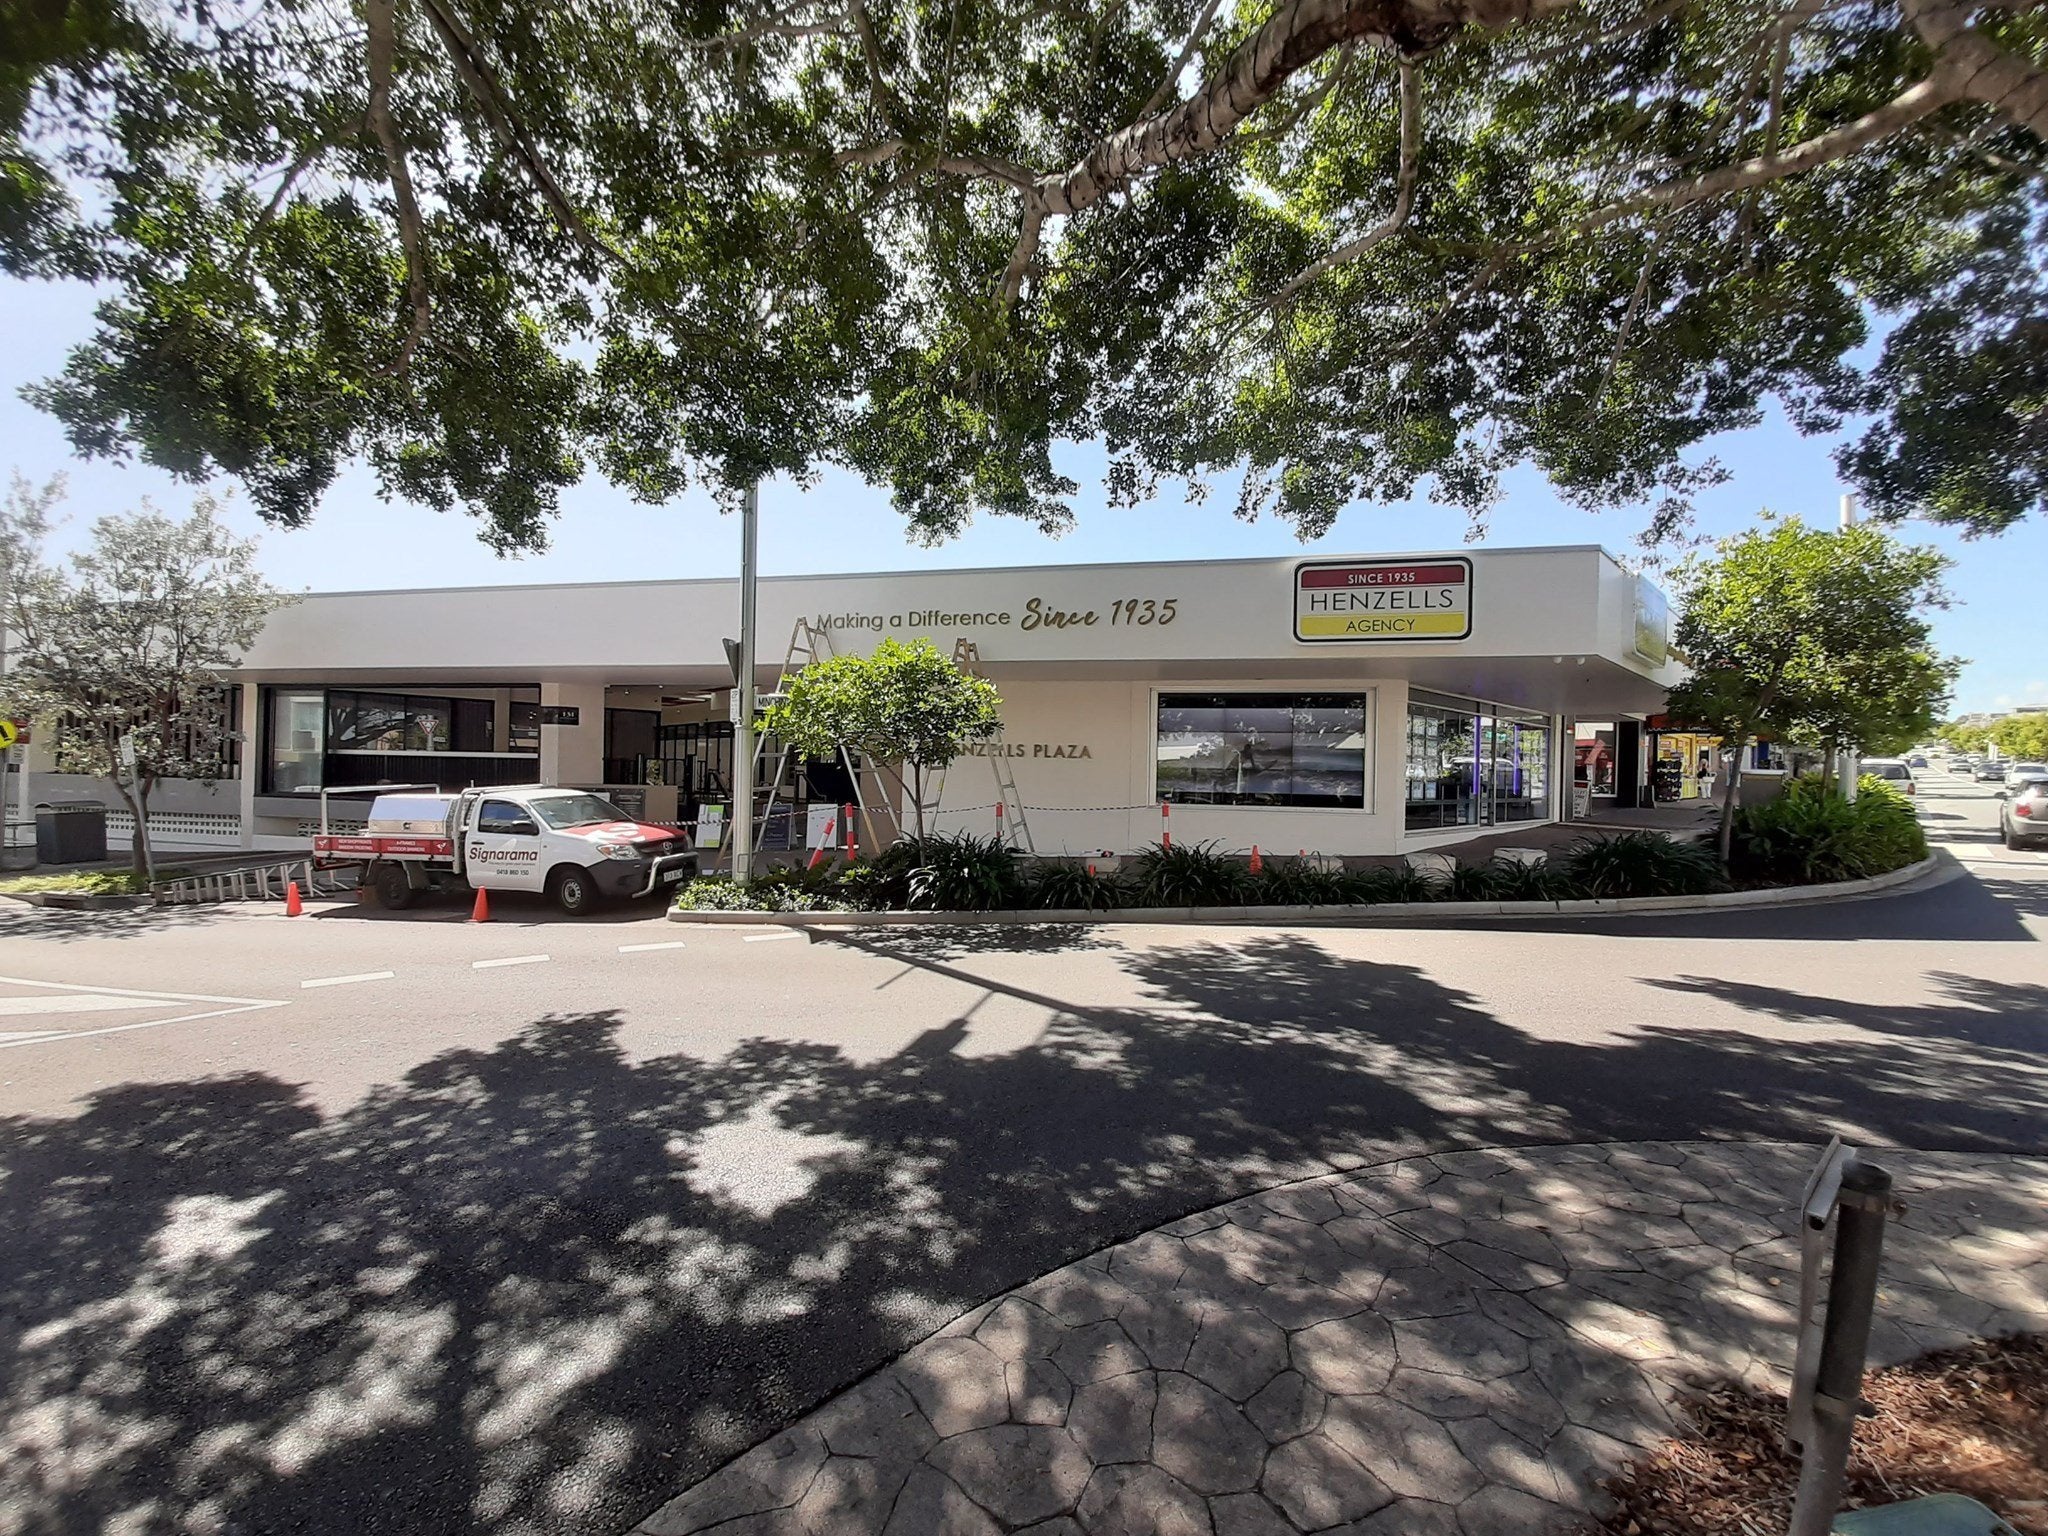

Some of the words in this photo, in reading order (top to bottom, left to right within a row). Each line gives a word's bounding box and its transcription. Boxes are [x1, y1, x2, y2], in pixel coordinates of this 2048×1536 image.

[1347, 573, 1383, 584] SINCE
[1387, 572, 1415, 584] 1935
[1310, 589, 1454, 611] HENZELLS
[817, 613, 883, 631] Making
[889, 614, 902, 628] a
[908, 610, 1011, 627] Difference
[1020, 597, 1100, 631] Since
[1110, 598, 1178, 626] 1935
[1346, 618, 1415, 633] AGENCY
[1033, 744, 1092, 759] PLAZA
[469, 847, 538, 863] Signarama
